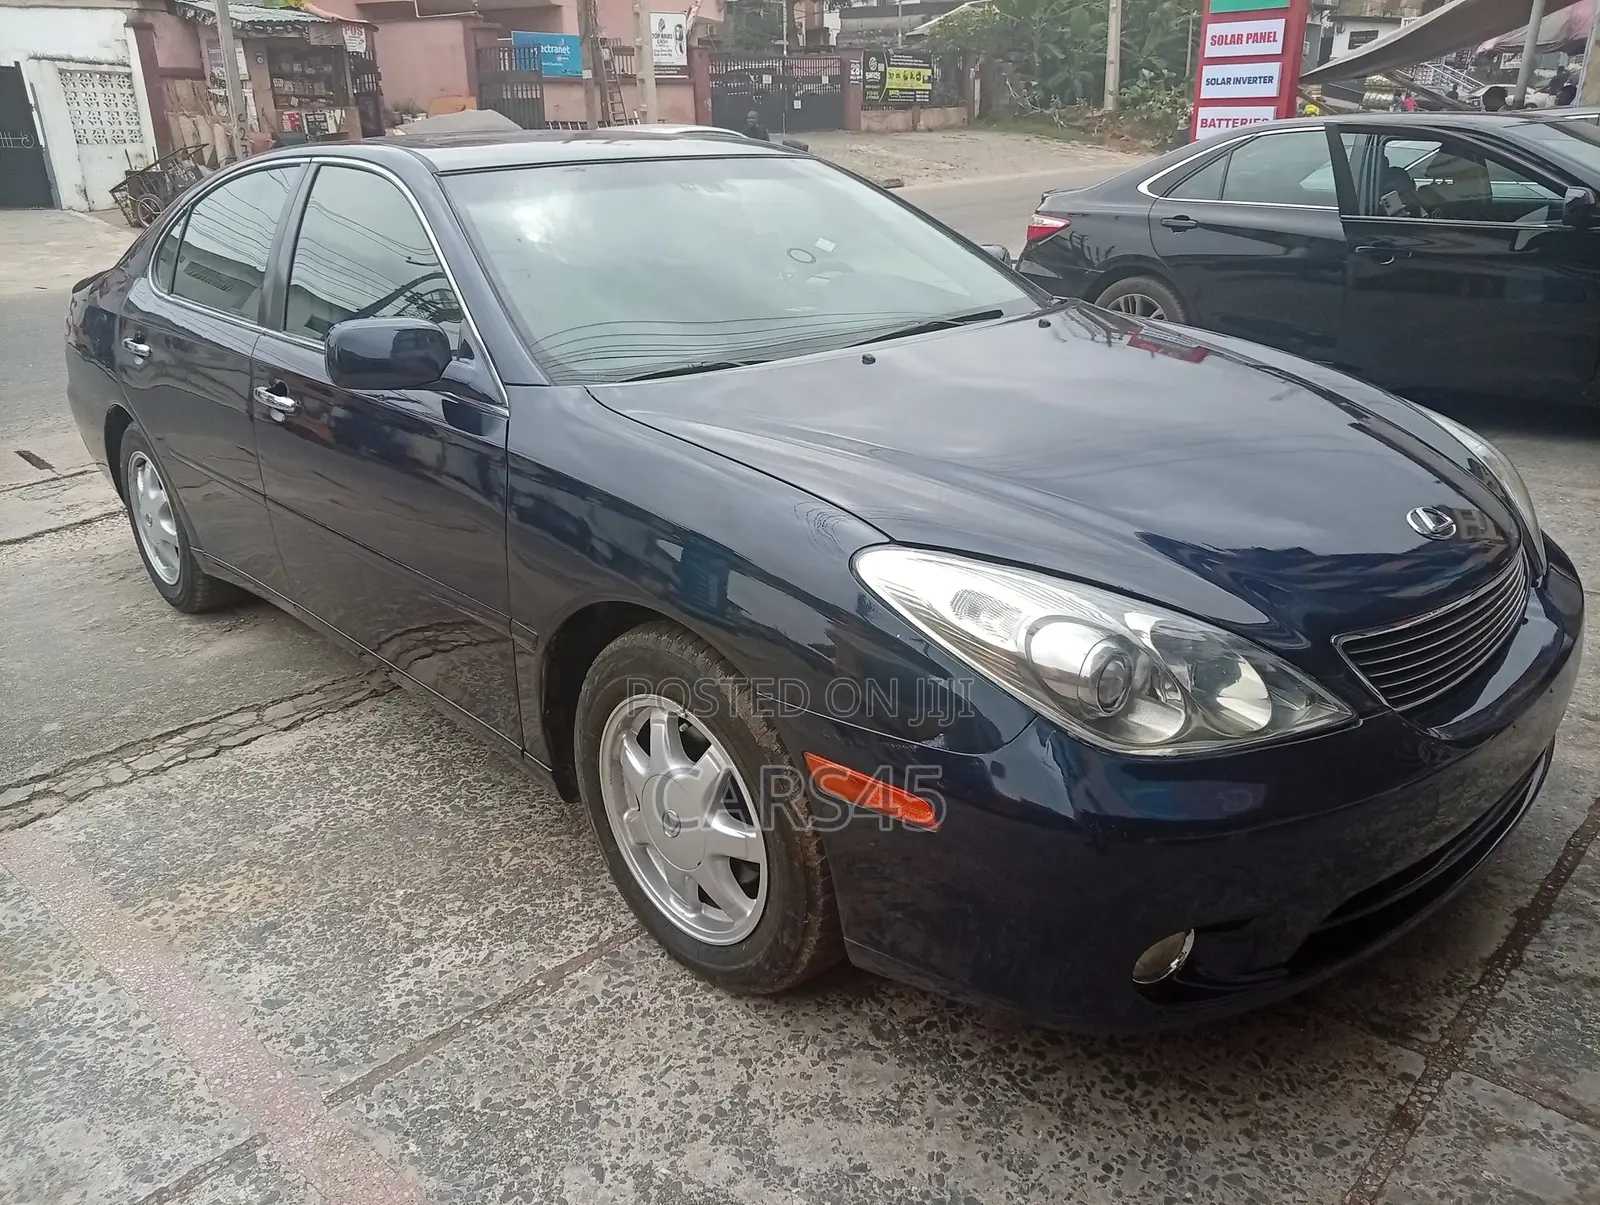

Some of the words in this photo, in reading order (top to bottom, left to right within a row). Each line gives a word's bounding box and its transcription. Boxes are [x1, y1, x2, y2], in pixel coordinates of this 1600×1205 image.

[344, 24, 363, 36] POS
[1210, 33, 1243, 46] SOLAR
[1245, 31, 1278, 44] PANEL
[531, 44, 571, 54] ectranet
[1205, 77, 1231, 86] SOLAR
[1232, 75, 1274, 85] INVERTER
[1200, 118, 1269, 128] BATTERI
